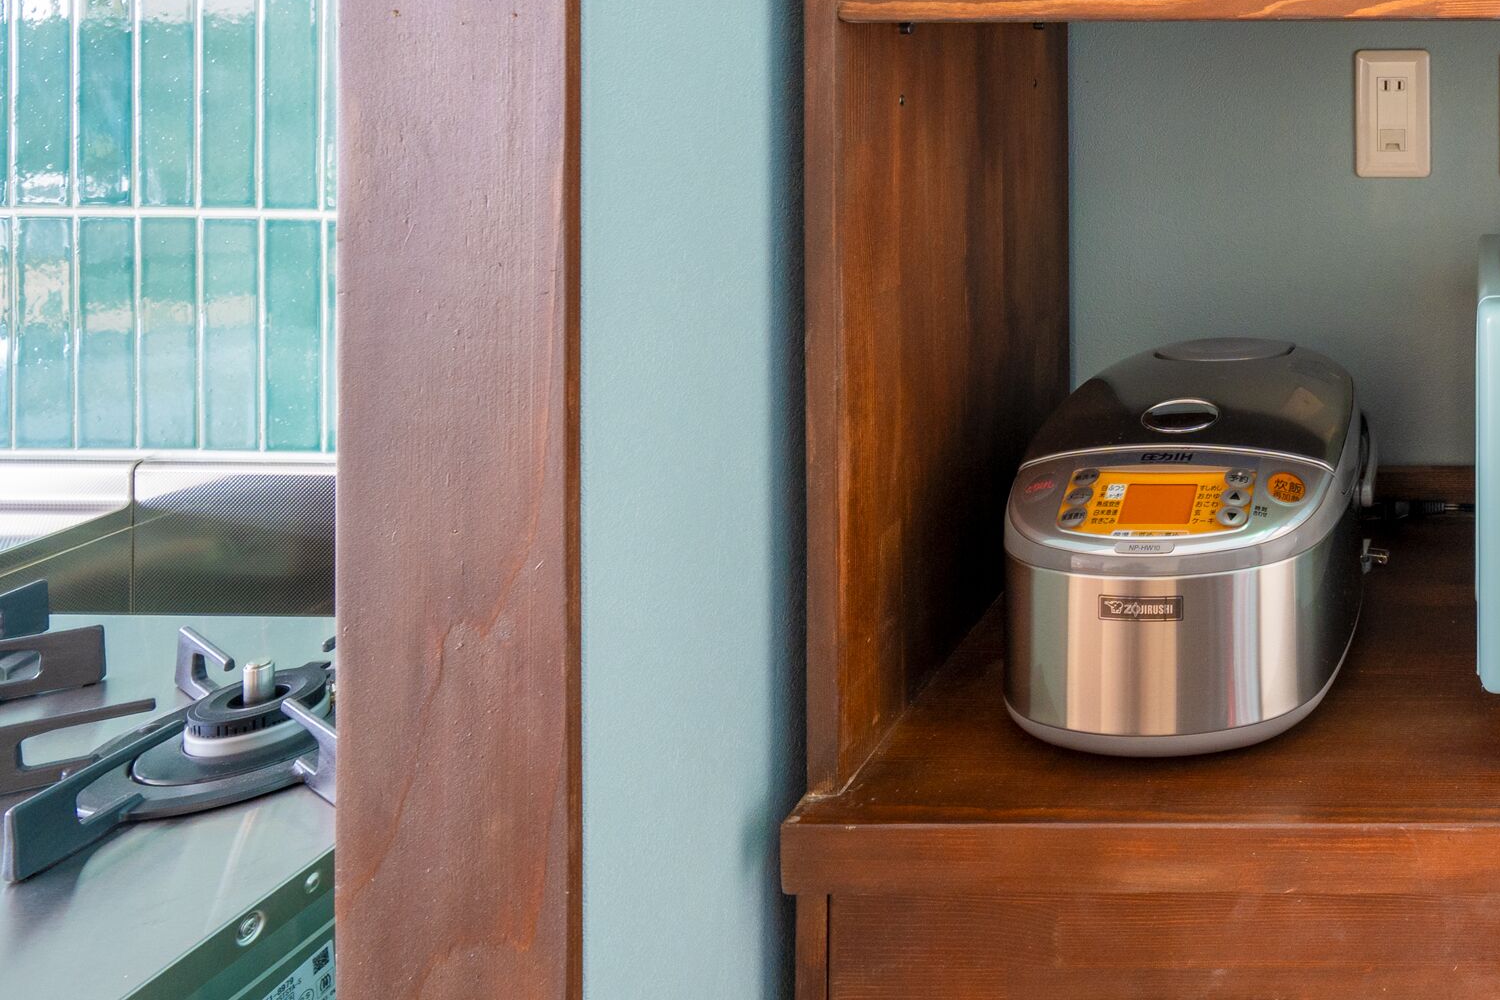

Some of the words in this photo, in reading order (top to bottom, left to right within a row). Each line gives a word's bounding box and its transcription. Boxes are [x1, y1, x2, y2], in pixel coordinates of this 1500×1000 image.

[1274, 479, 1303, 493] 炊飯
[1128, 544, 1161, 553] NP-HW10
[1123, 601, 1174, 618] ZOJIRUSHI
